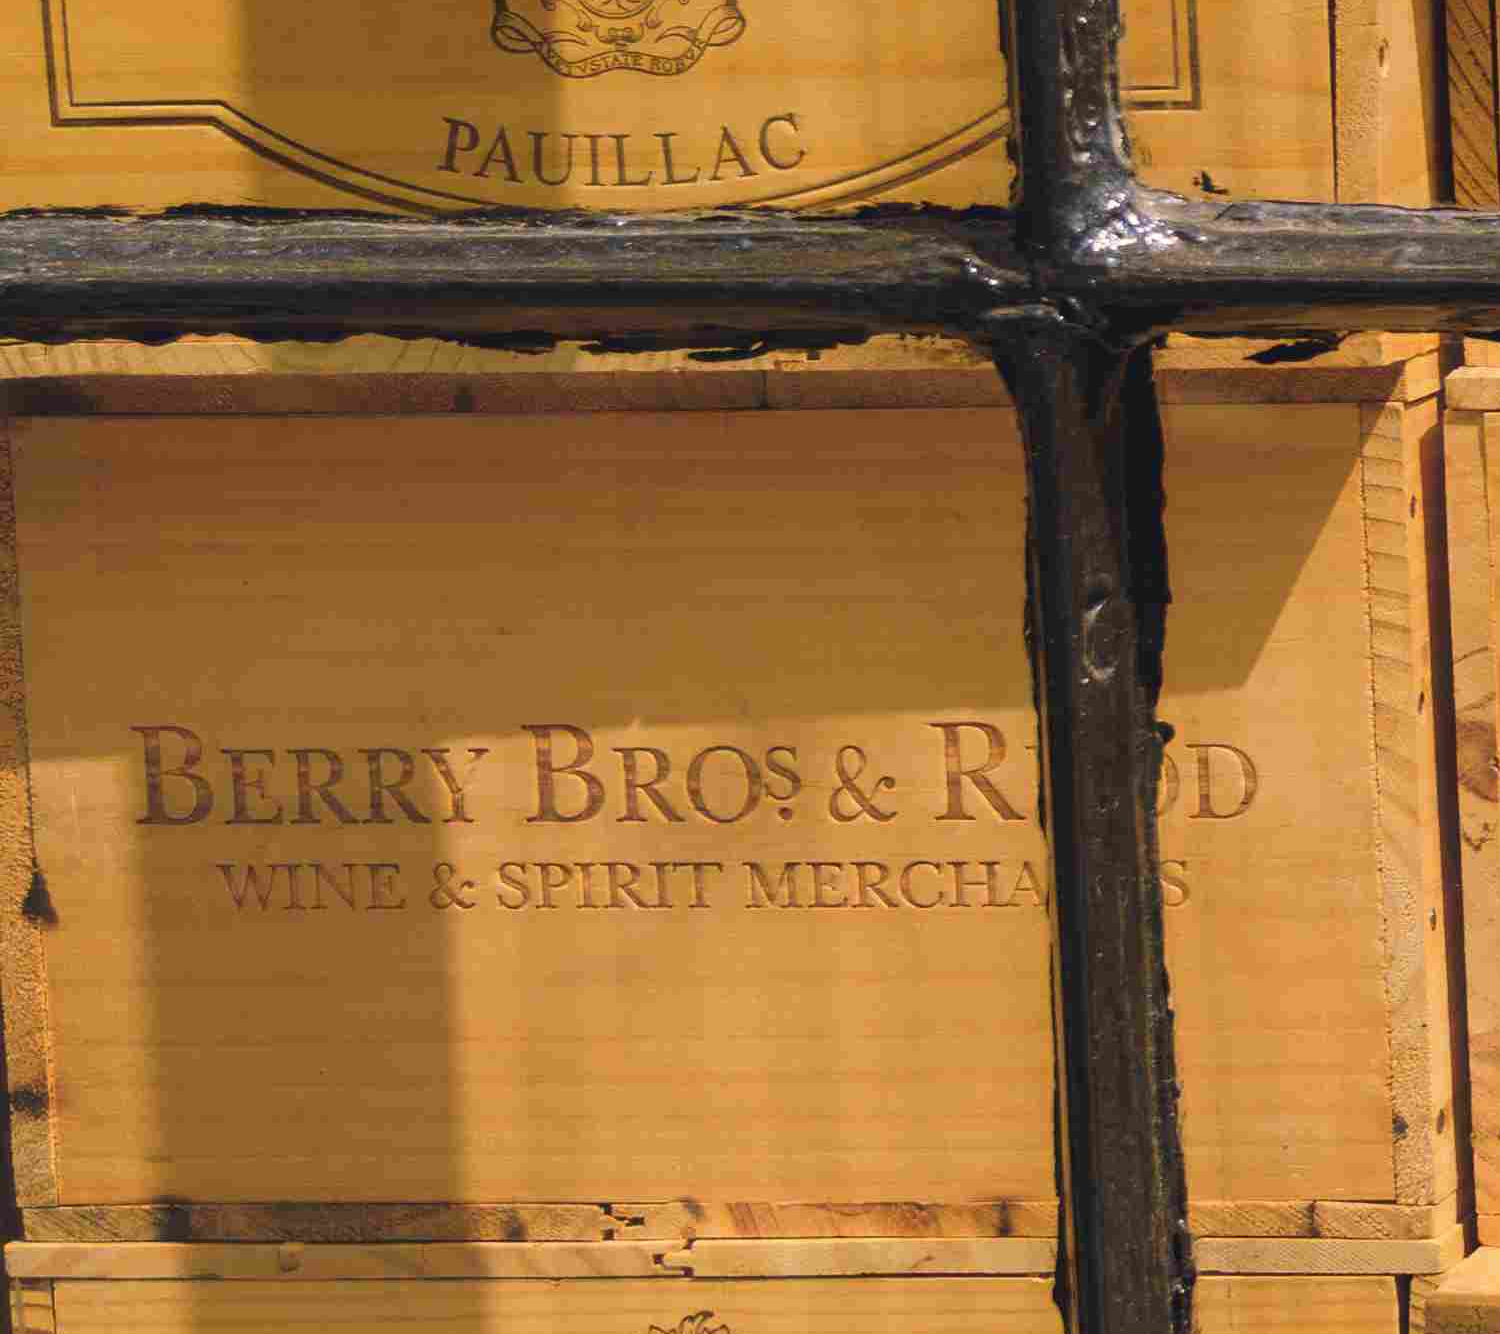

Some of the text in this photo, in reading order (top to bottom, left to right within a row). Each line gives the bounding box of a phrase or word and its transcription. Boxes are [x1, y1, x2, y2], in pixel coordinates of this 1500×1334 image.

[440, 110, 808, 190] PAUILLAC
[130, 721, 488, 830] BERRY
[828, 744, 899, 825] &
[928, 720, 1261, 827] RD
[214, 857, 1192, 917] WINE & SPIRIT MERCHAS
